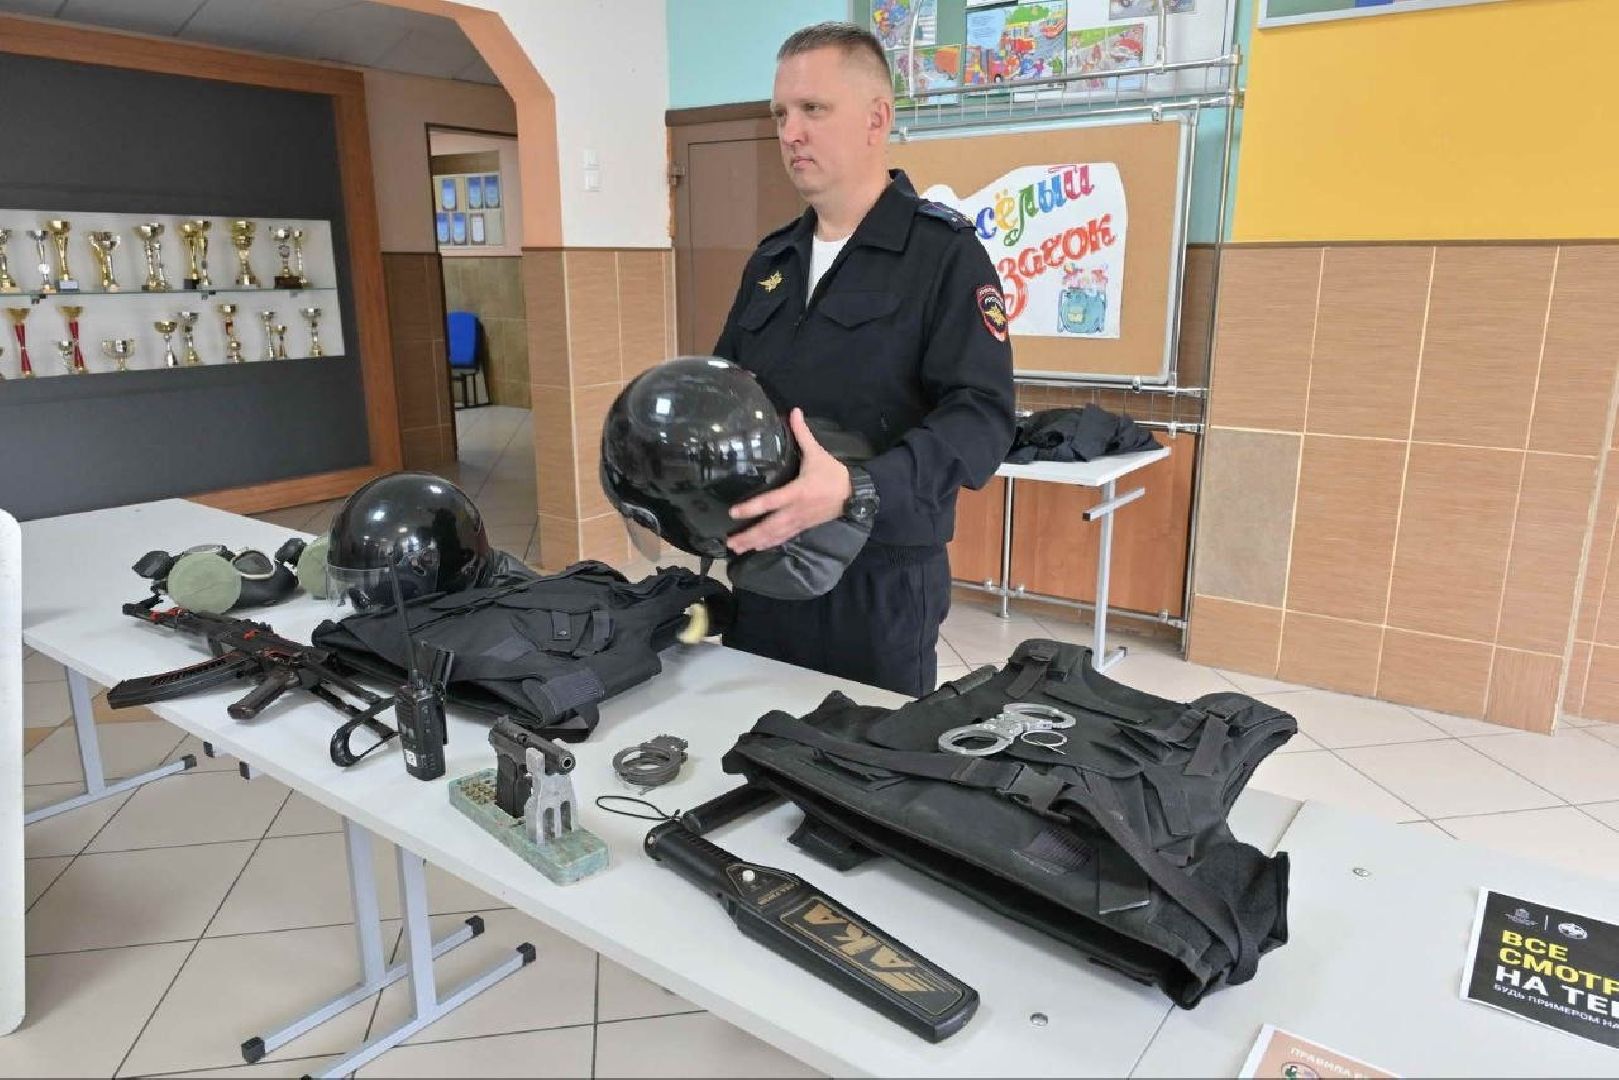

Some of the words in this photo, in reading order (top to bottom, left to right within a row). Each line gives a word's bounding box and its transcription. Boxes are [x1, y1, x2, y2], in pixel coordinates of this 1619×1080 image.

[1501, 930, 1568, 962] ВСЕ
[1495, 964, 1549, 996] НА
[1528, 995, 1600, 1025] ПРИМЕРОМ
